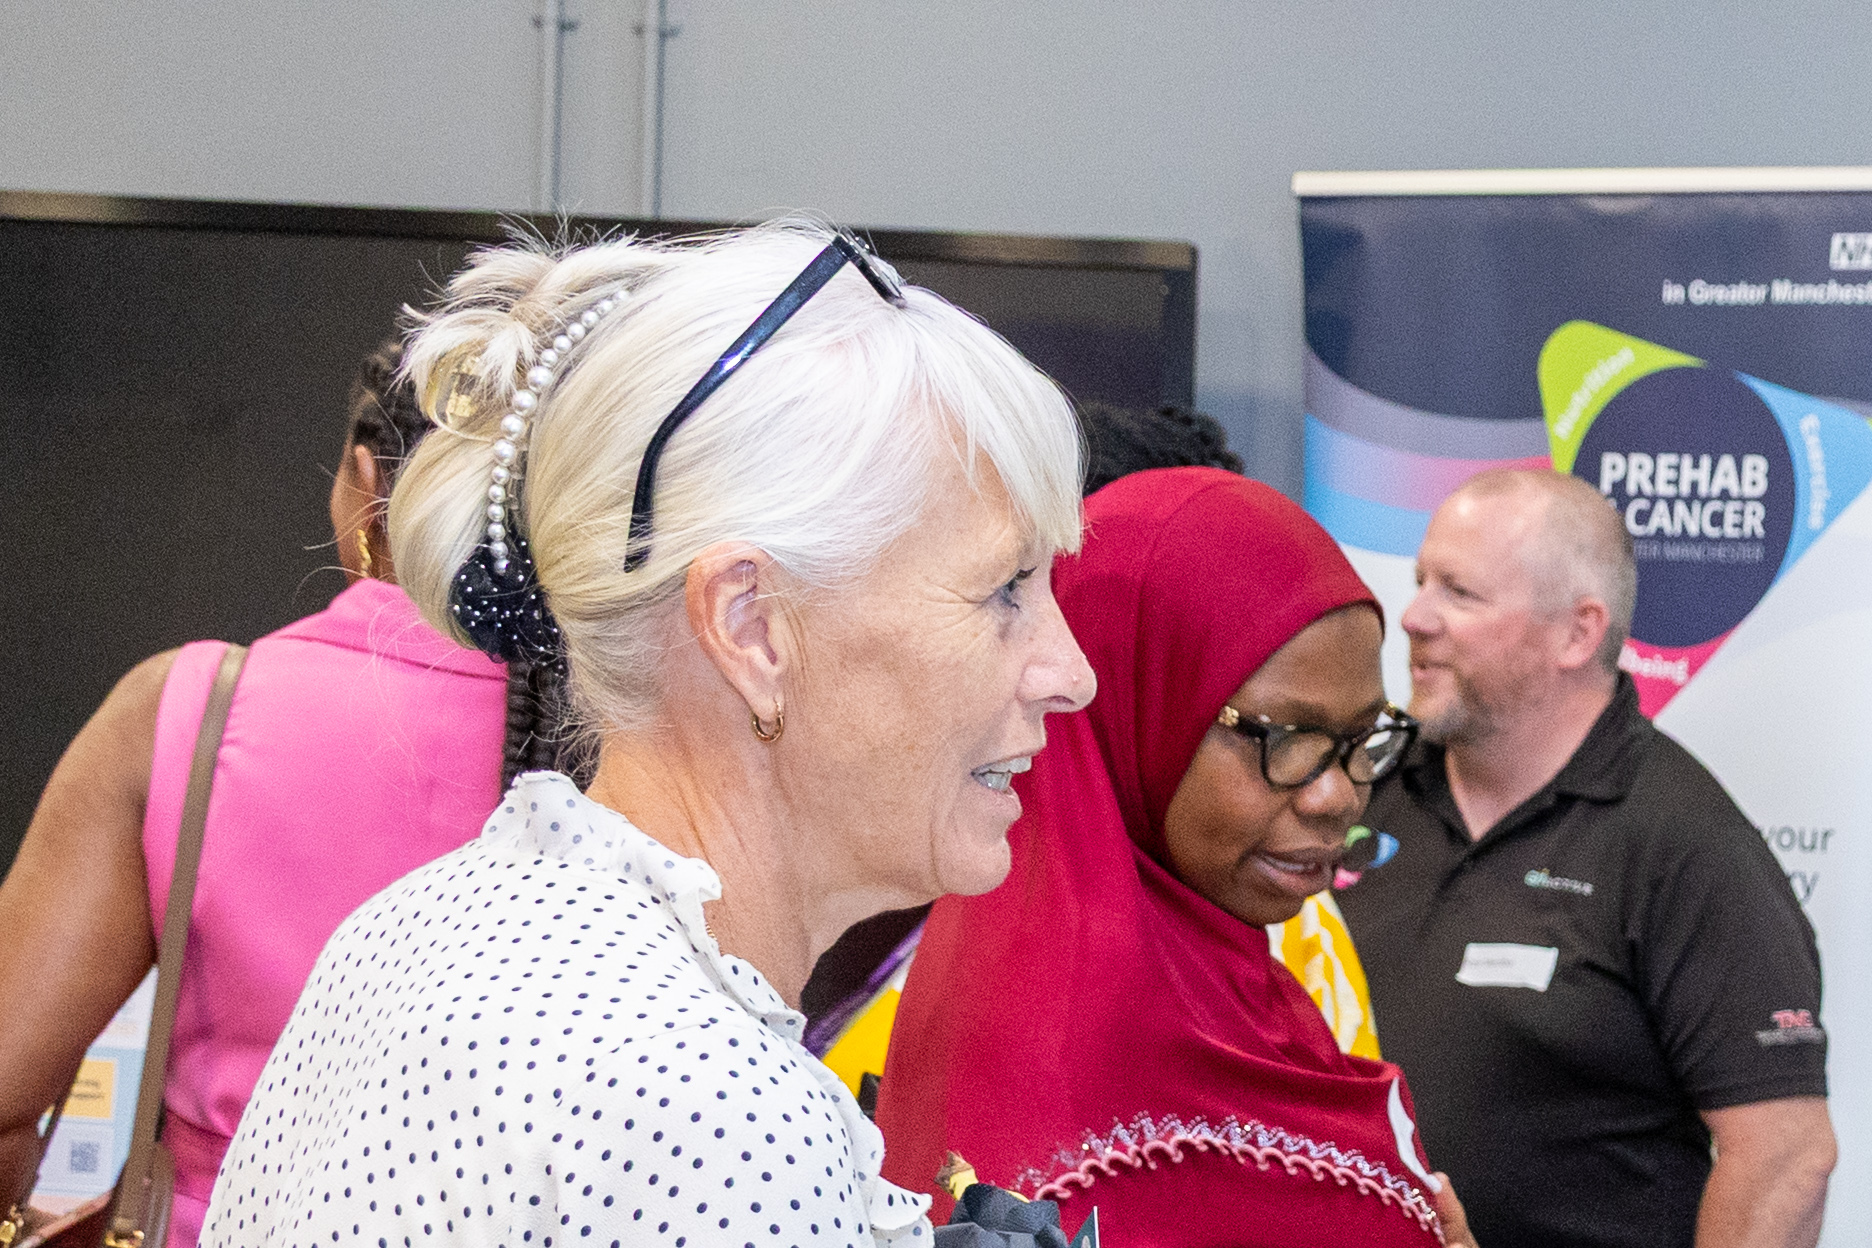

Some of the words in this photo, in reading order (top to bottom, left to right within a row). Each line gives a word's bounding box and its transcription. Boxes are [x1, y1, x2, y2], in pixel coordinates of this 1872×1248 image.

[1662, 279, 1685, 304] in
[1689, 280, 1768, 305] Greater
[1600, 452, 1769, 498] PREHAB
[1625, 499, 1766, 540] CANCER
